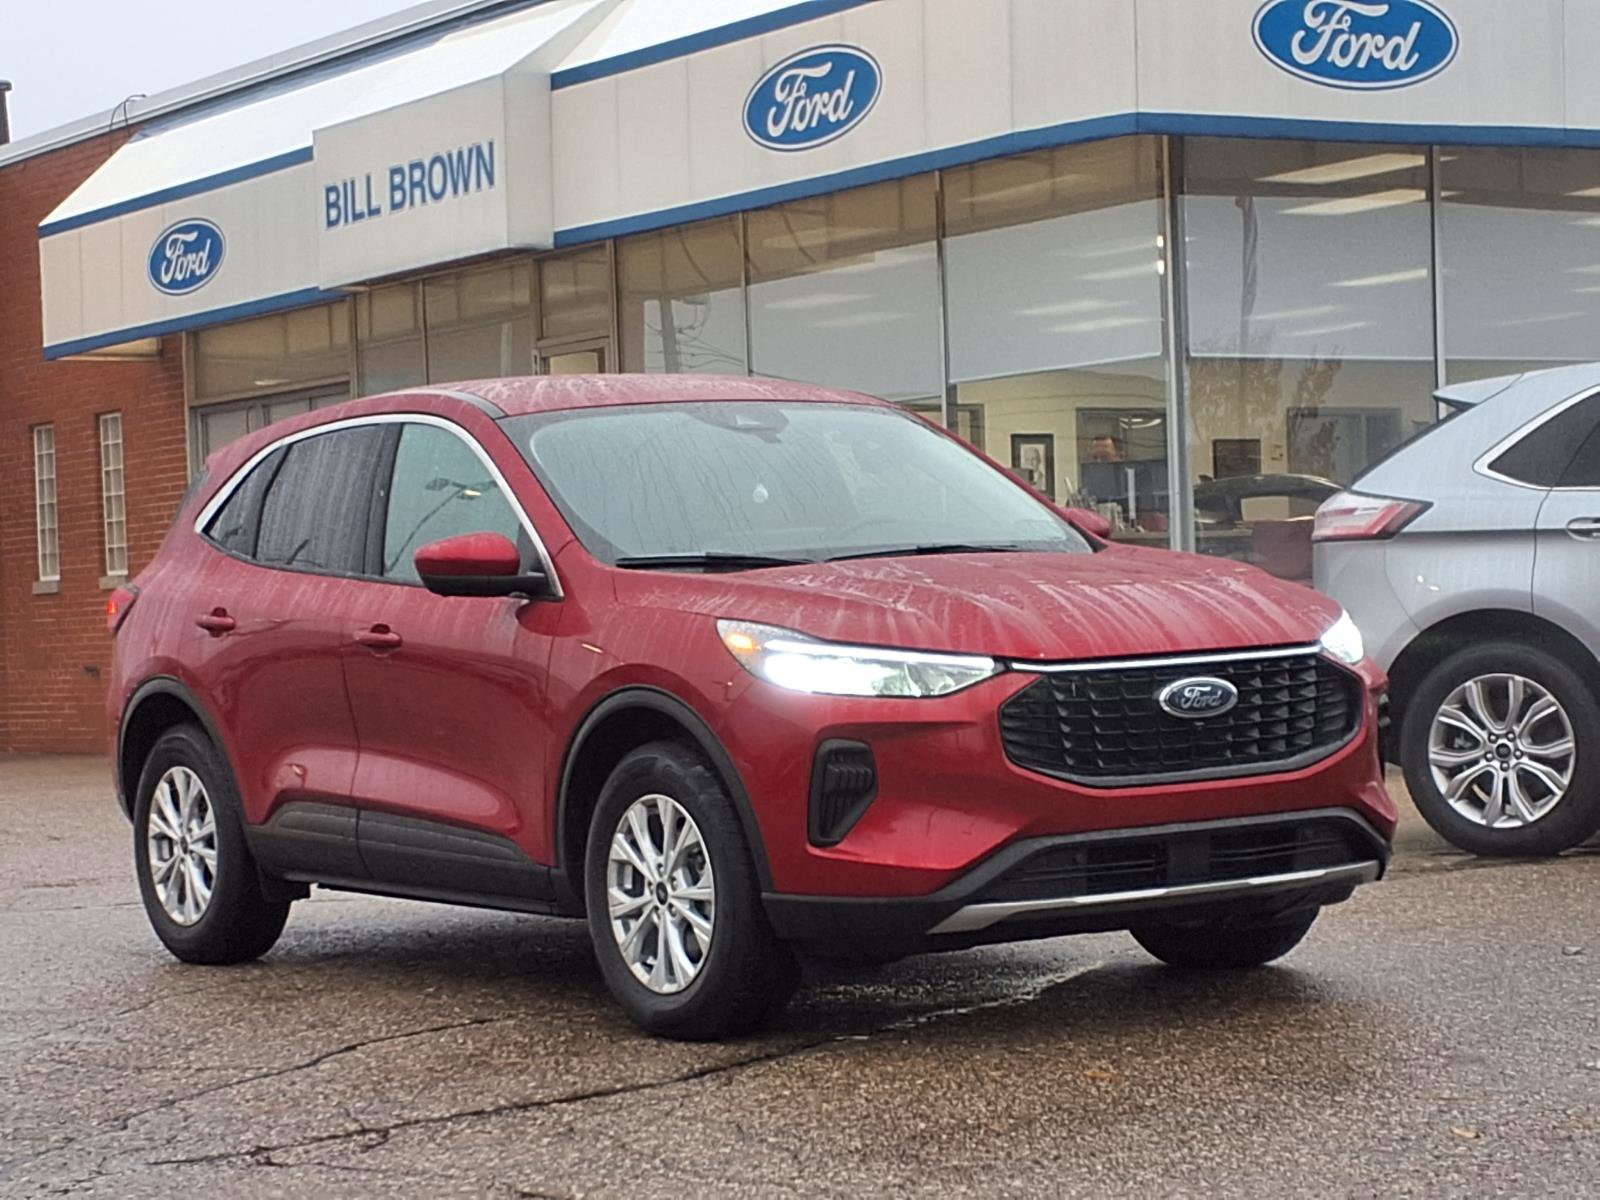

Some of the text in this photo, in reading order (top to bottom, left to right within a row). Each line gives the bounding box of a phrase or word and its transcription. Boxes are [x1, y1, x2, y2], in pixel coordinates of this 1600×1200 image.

[1291, 0, 1422, 71] Ford
[766, 61, 855, 137] Ford
[325, 140, 495, 229] BILL BROWN
[161, 230, 212, 284] Ford
[1181, 686, 1222, 709] Ford
